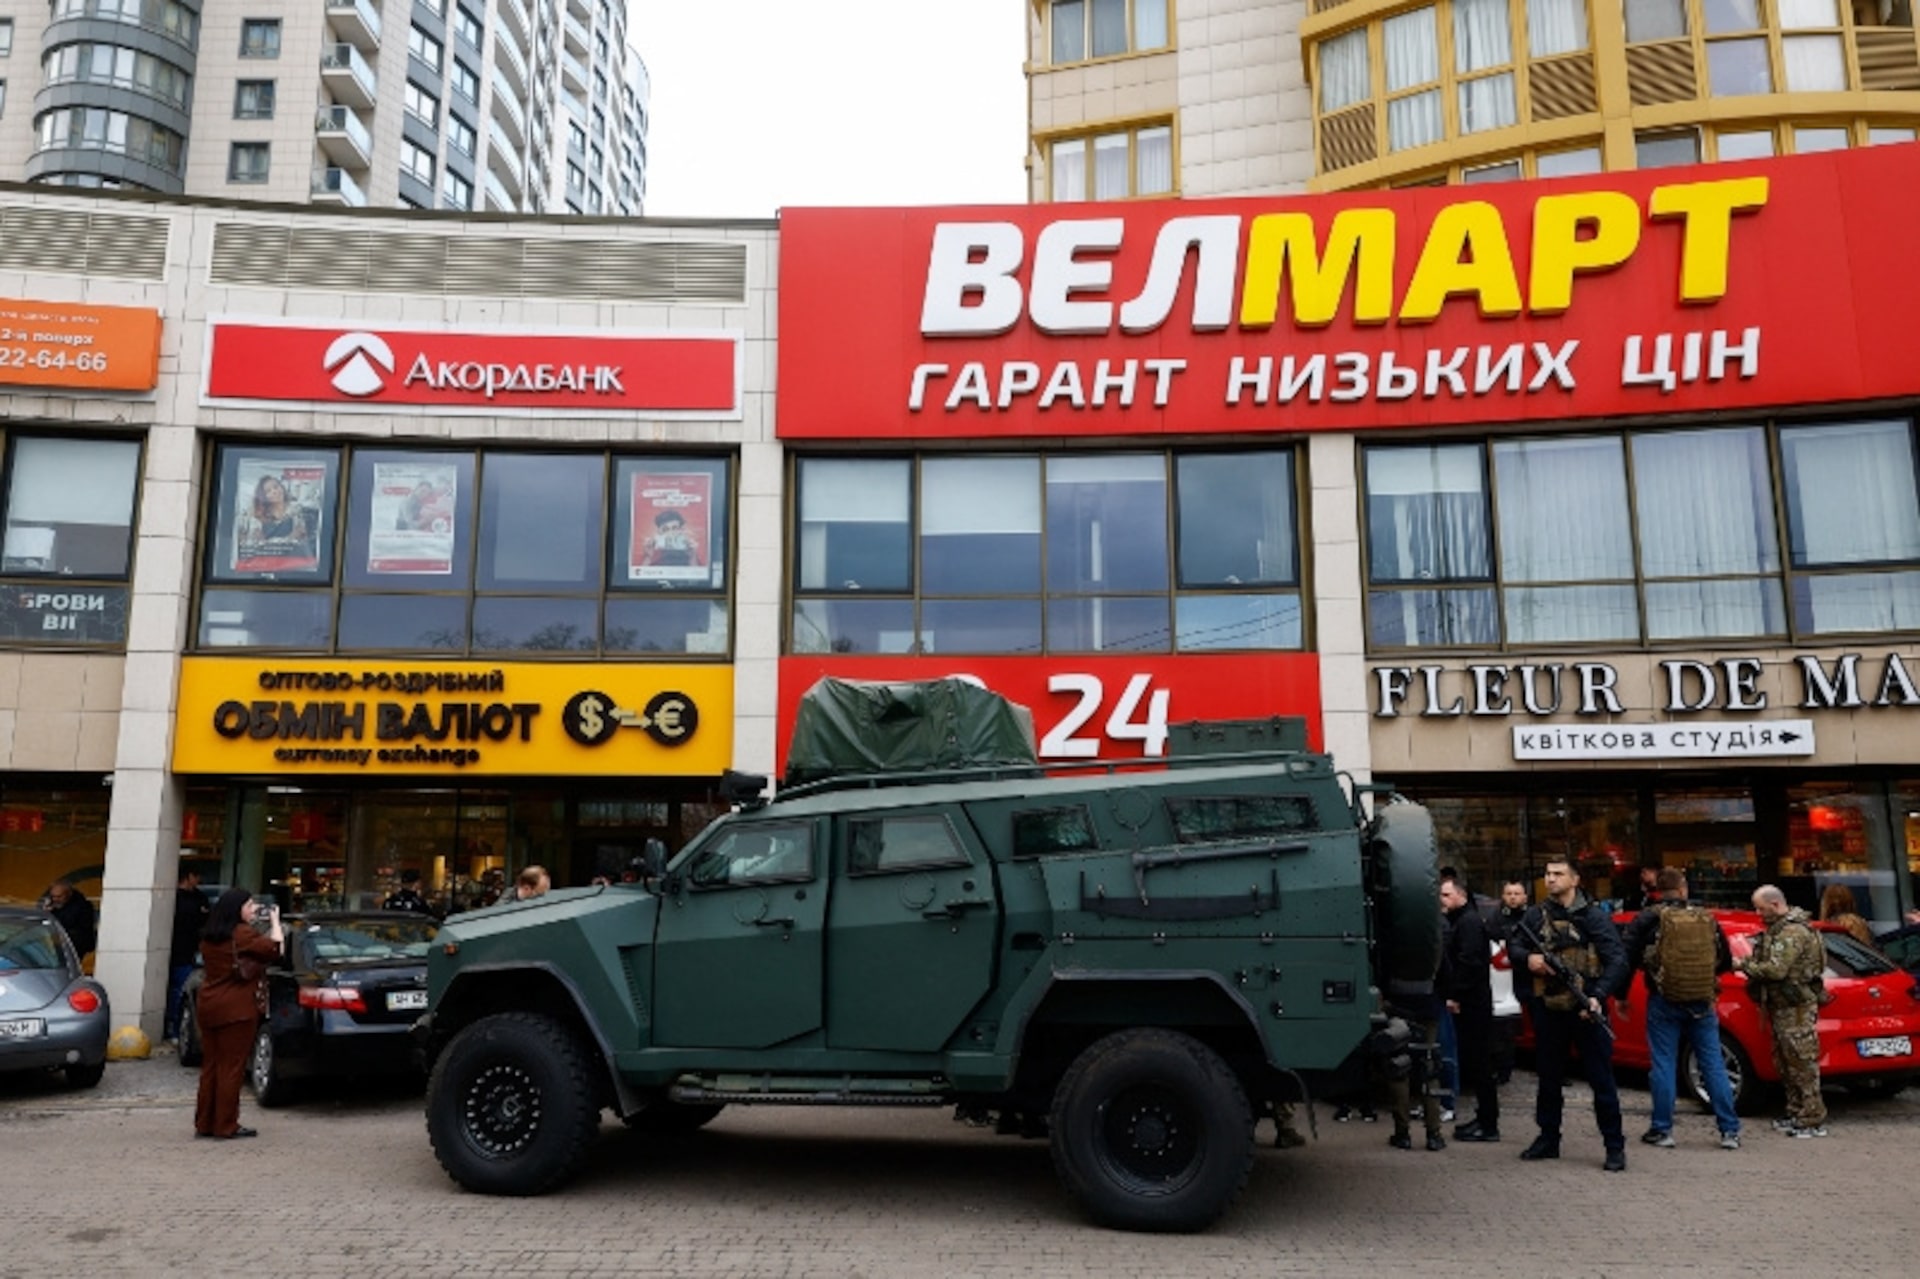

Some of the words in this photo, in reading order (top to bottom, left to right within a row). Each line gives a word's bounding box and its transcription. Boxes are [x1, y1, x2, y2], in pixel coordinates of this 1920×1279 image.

[920, 176, 1769, 336] ВЕЛМАРТ
[908, 358, 1188, 411] ГАРАНТ
[1225, 339, 1580, 405] НИЗЬКИХ
[1621, 326, 1761, 393] ЦІН
[19, 592, 104, 611] БРОВИ
[259, 670, 504, 695] ОПТОВО-РОЗДРІБНИЙ
[1373, 662, 1627, 718] FLEUR
[1659, 658, 1767, 712] DE
[213, 700, 366, 741] ОБМІН
[376, 702, 541, 743] ВАЛЮТ
[1038, 673, 1170, 758] 24
[274, 748, 372, 766] currency
[377, 744, 480, 767] exchange
[1520, 729, 1655, 750] квіткова
[1670, 724, 1773, 751] студія
